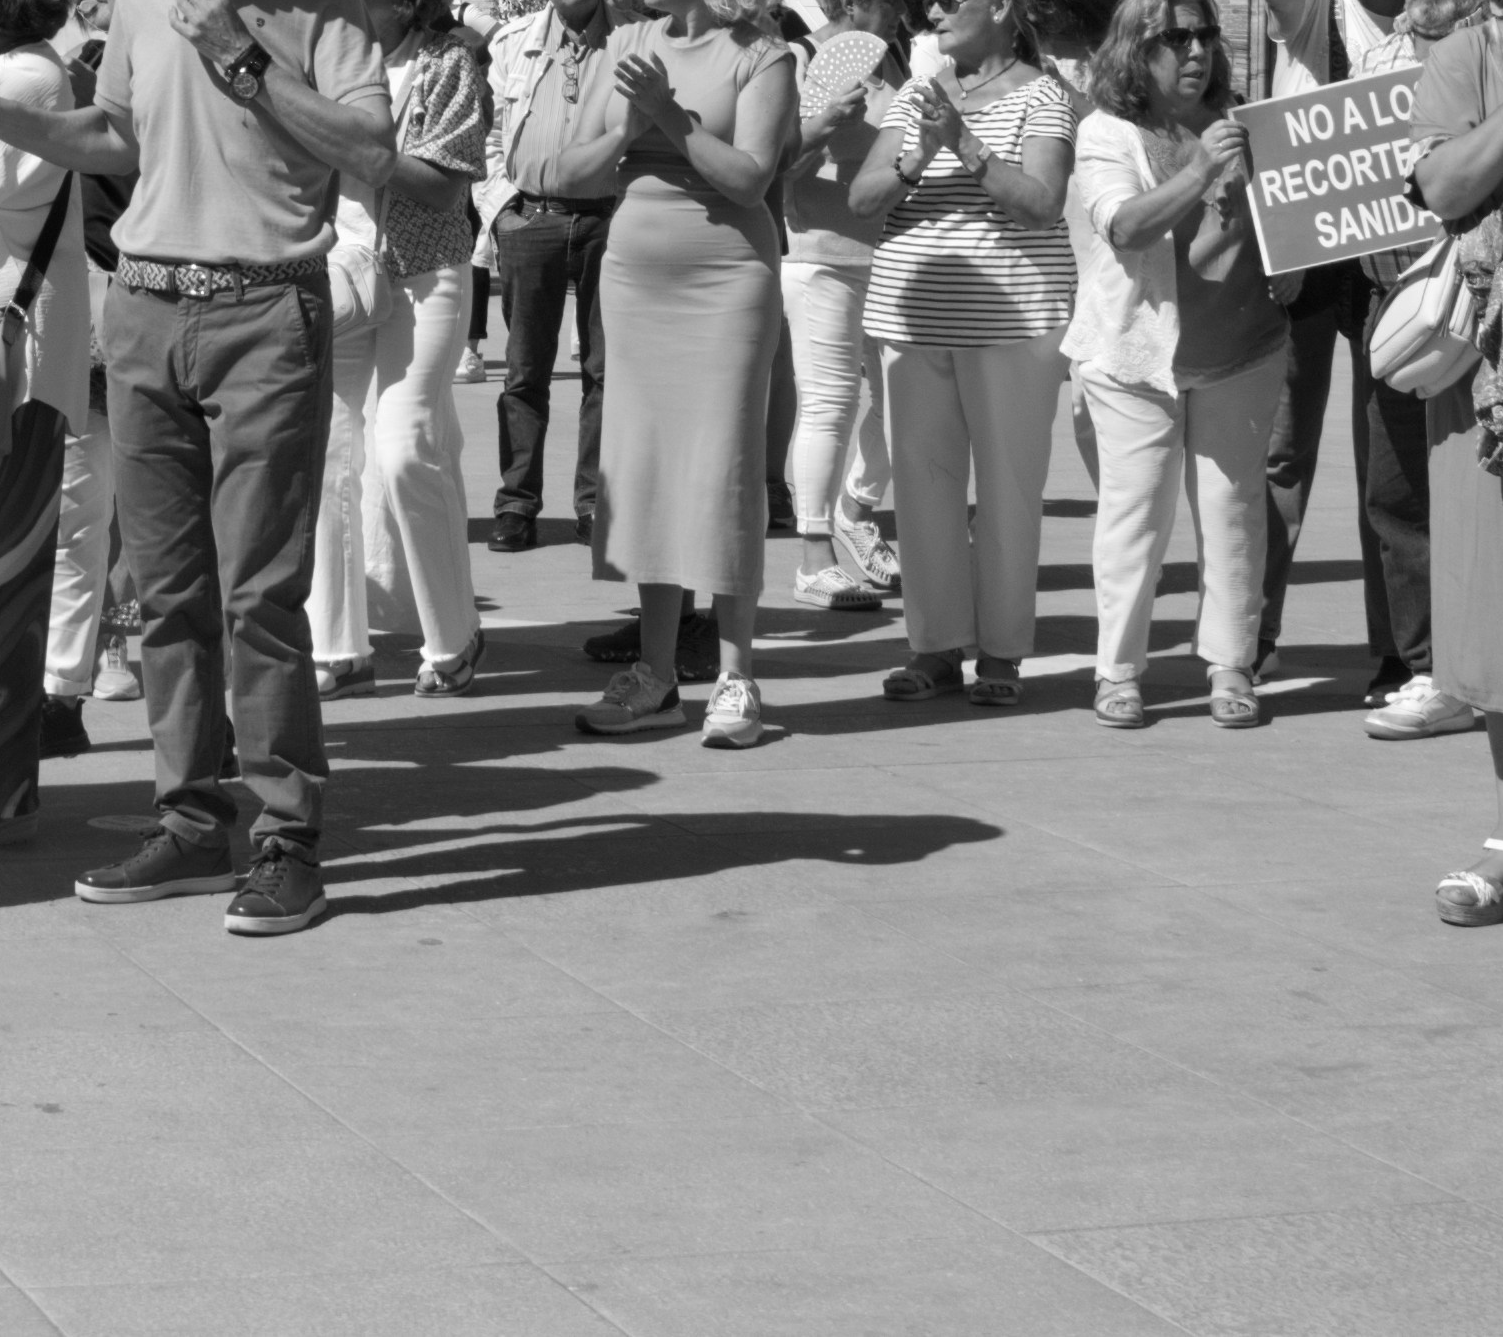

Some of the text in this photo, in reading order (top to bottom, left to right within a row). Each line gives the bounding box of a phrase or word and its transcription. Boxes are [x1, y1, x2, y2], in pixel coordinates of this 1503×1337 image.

[1284, 80, 1418, 147] NO A LO
[1259, 137, 1414, 207] RECORTE
[1314, 194, 1443, 249] SANIDA
